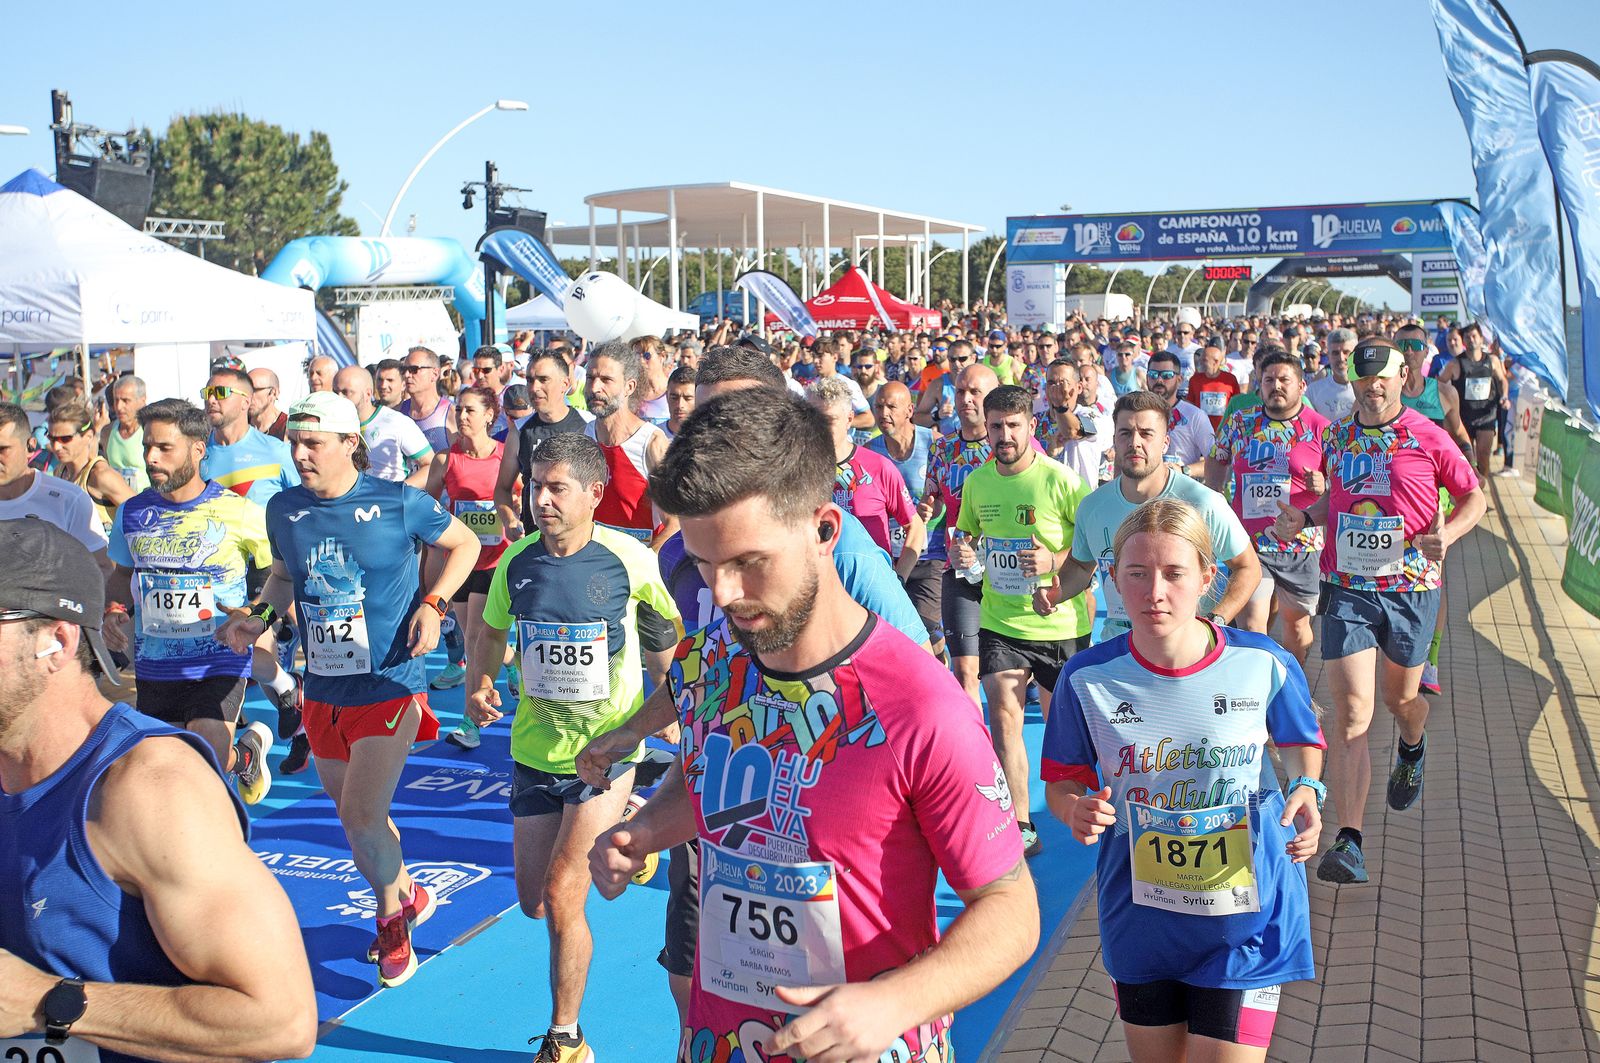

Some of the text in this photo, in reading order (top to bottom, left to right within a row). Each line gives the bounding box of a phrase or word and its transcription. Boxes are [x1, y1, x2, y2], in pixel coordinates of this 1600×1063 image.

[1159, 214, 1261, 229] CAMPEONATO
[1338, 219, 1382, 234] HUELVA
[1419, 219, 1444, 232] Wi
[1157, 226, 1298, 245] de ESPAÑA 10 km
[1206, 245, 1224, 253] ruta
[1225, 243, 1261, 252] Absoluto
[1262, 245, 1268, 253] y
[1269, 242, 1298, 251] Master
[770, 319, 856, 331] SPOANIACS
[1248, 439, 1275, 471] 10
[1342, 451, 1374, 495] 10
[1250, 485, 1281, 498] 1825
[463, 513, 495, 525] 1669
[1378, 521, 1397, 529] 2023
[1015, 541, 1032, 549] 2023
[1347, 531, 1392, 550] 1299
[992, 553, 1017, 569] 100
[184, 578, 204, 588] 2023
[59, 598, 83, 614] FILA
[153, 592, 201, 609] 1874
[333, 607, 355, 618] 2023
[311, 623, 354, 644] 1012
[537, 628, 555, 636] HUELVA
[575, 628, 598, 639] 2023
[535, 643, 594, 666] 1585
[558, 686, 580, 694] Syrluz
[1231, 700, 1260, 708] Bollullos
[1114, 737, 1257, 778] Atletismo
[774, 750, 823, 788] HU
[405, 776, 512, 800] elva
[701, 732, 775, 850] 10
[770, 780, 812, 817] EL
[769, 804, 809, 844] VA
[1151, 815, 1175, 828] HUELVA
[1204, 811, 1236, 830] 2023
[767, 837, 808, 857] PUERTA DEL
[1148, 836, 1228, 868] 1871
[253, 852, 357, 872] UELV
[717, 859, 743, 879] HUELVA
[271, 868, 360, 883] Ayuntamie
[774, 874, 818, 895] 2023
[1155, 878, 1231, 891] VILLEGAS VILLEGAS
[1144, 892, 1215, 906] HYUNDAI Syrluz
[722, 892, 798, 946] 756
[749, 946, 775, 960] SERGIO
[740, 959, 792, 978] BARBA RAMOS
[711, 976, 776, 997] HYUNDAI Syr
